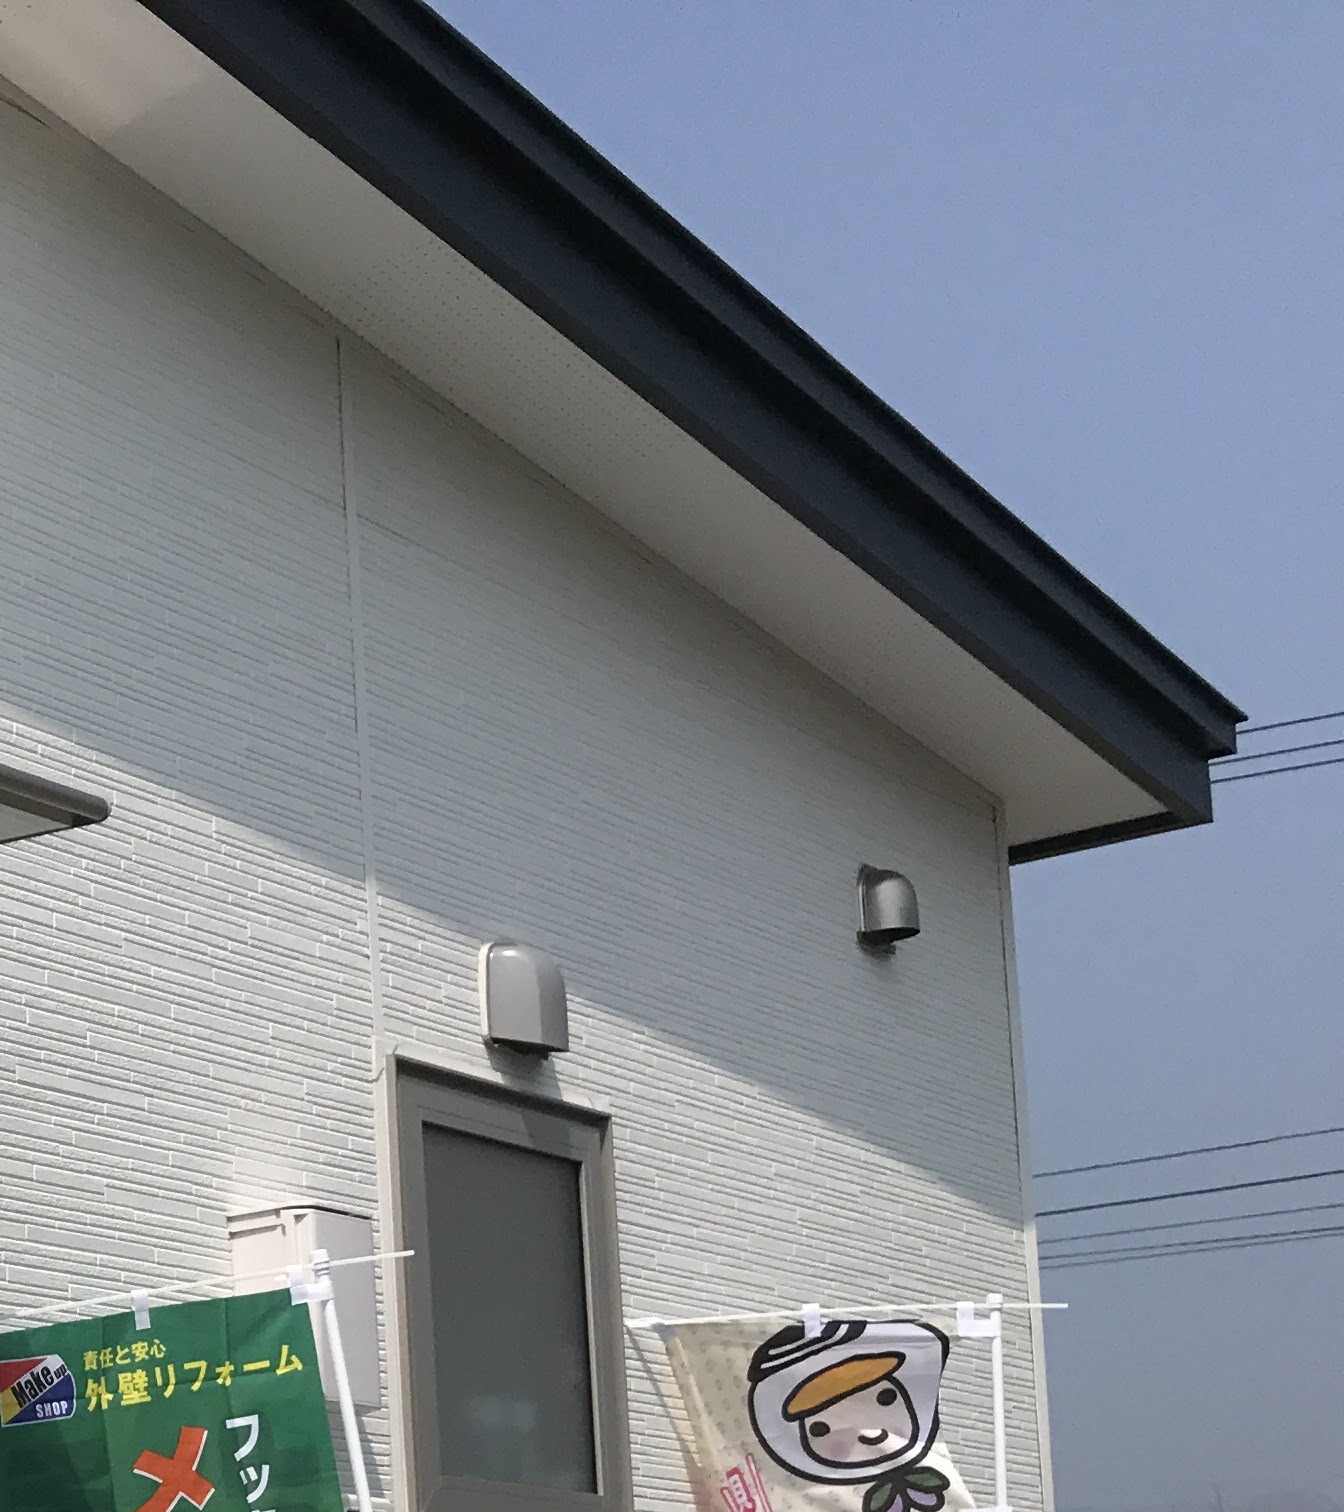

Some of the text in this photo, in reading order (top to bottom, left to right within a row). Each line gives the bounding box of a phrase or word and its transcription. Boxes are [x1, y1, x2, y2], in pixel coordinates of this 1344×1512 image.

[83, 1339, 167, 1371] 責任と安心
[10, 1366, 55, 1409] Make
[85, 1344, 303, 1412] 外壁リフォーム
[35, 1400, 68, 1418] SHOP
